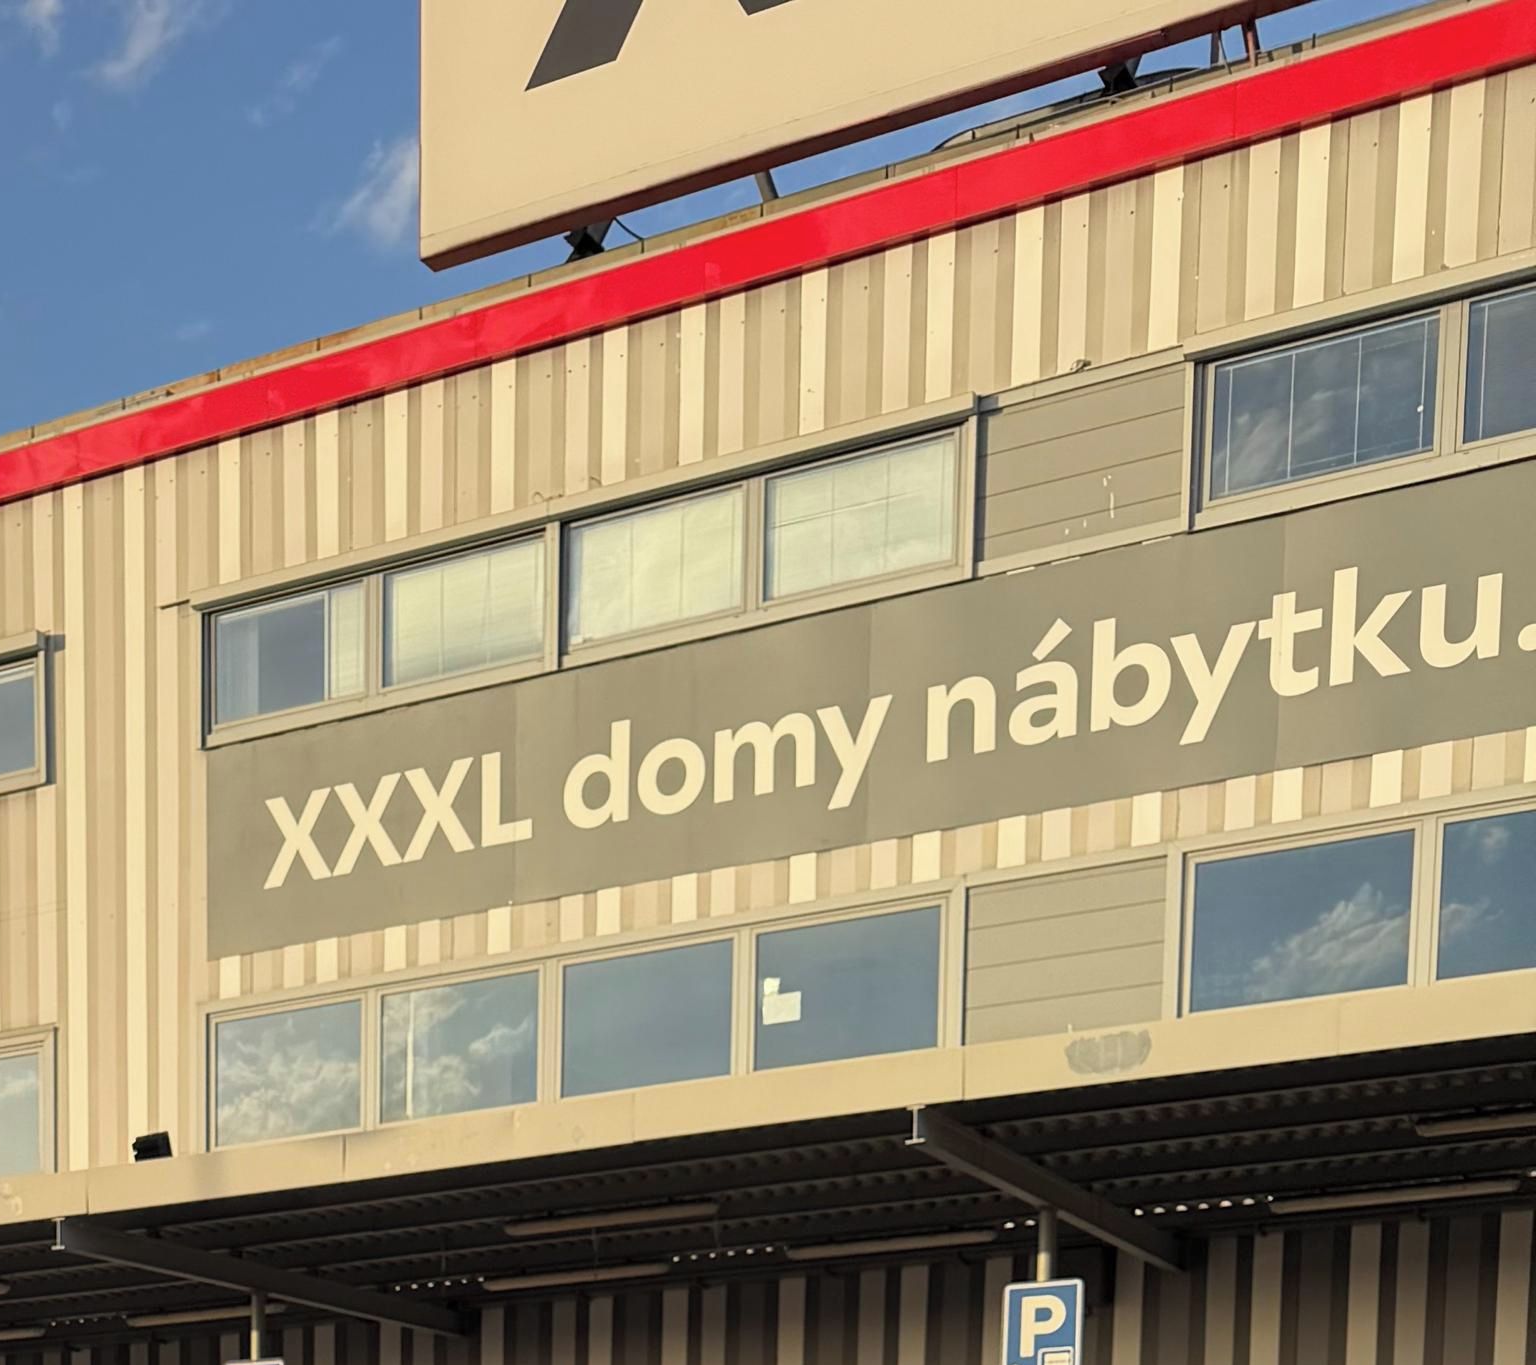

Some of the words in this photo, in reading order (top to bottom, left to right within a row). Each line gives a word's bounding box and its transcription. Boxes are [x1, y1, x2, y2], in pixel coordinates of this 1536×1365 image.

[264, 752, 532, 890] XXXL
[562, 694, 893, 828] domy
[925, 566, 1536, 763] nábytku.
[1019, 1294, 1066, 1358] P
